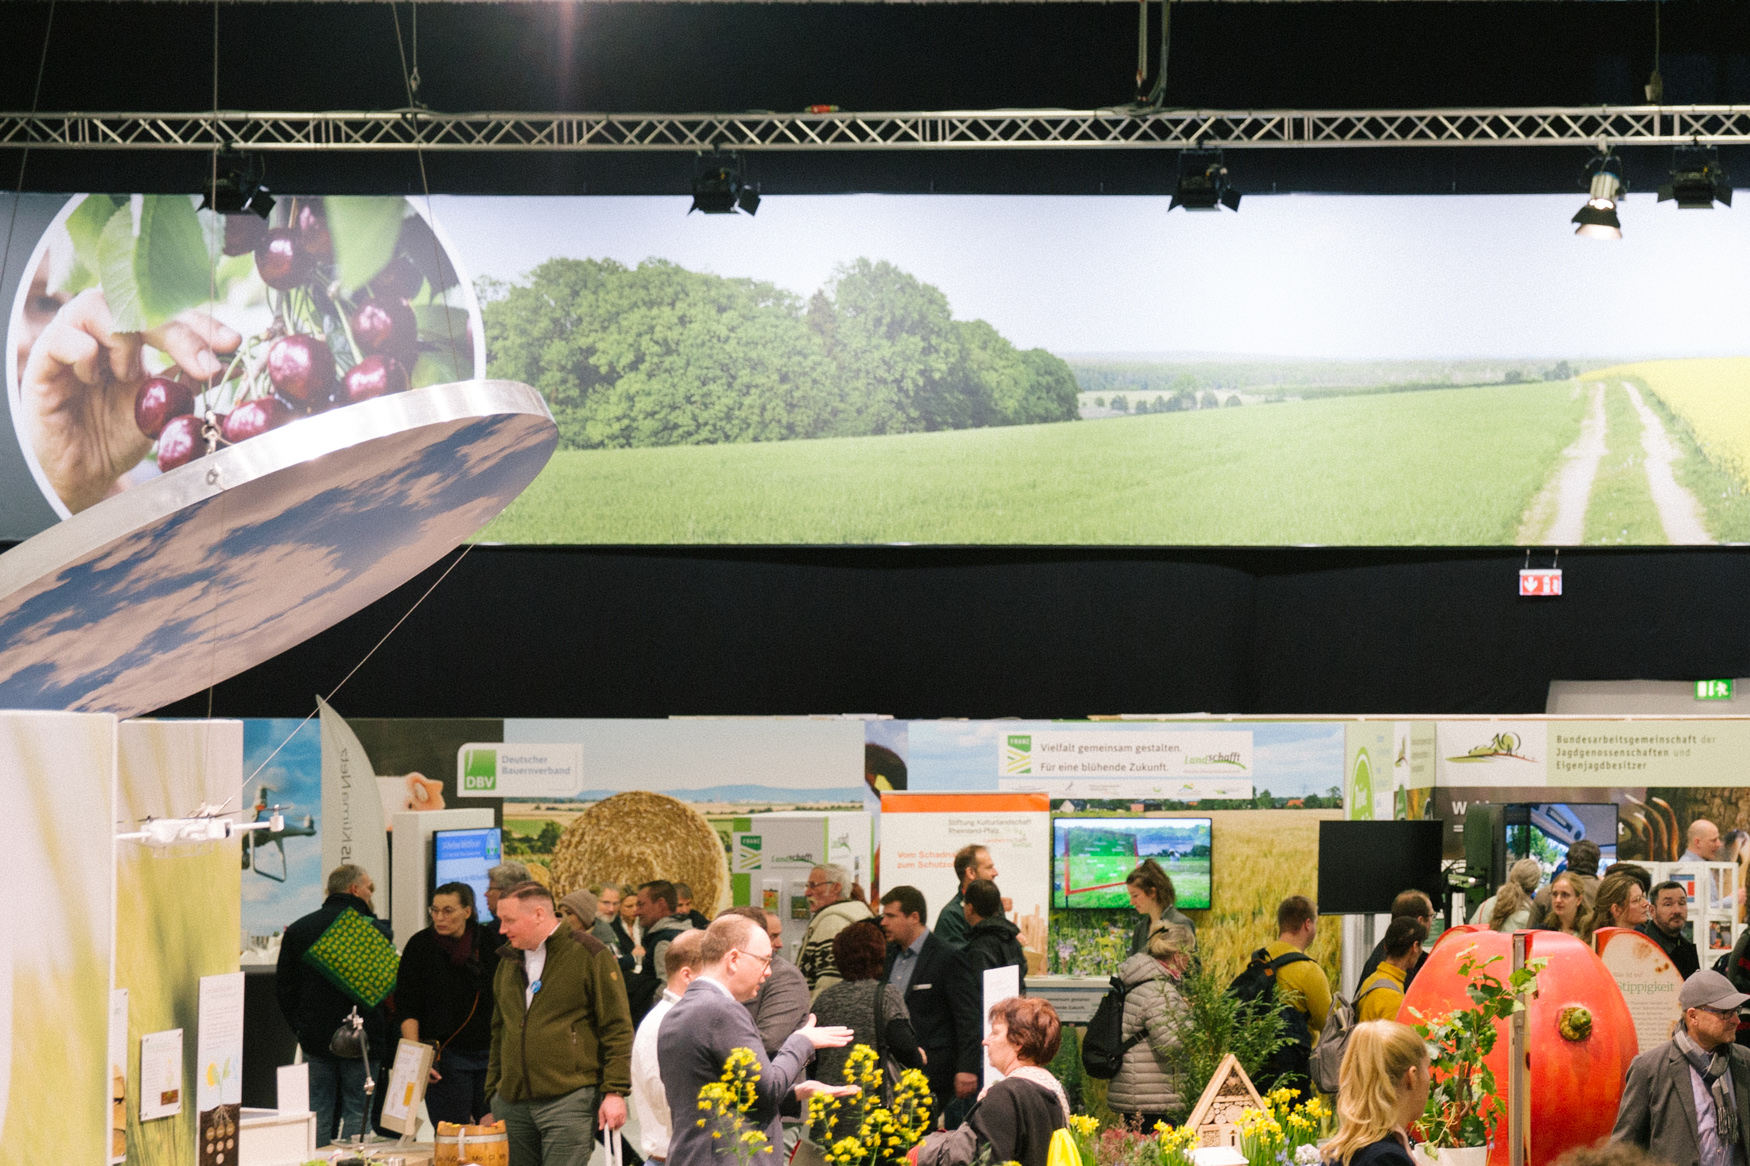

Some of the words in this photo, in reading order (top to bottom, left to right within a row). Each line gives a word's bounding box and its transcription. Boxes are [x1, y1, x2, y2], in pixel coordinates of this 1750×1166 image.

[1556, 735, 1697, 746] Bundesarbeitsgemeinschaft
[1701, 736, 1717, 744] der
[1041, 743, 1075, 752] Vielfalt
[1078, 744, 1133, 754] gemeinsam
[1135, 743, 1182, 754] gestalten.
[1556, 748, 1669, 760] Jagdgenossenschaften
[1674, 748, 1691, 757] und
[502, 755, 547, 764] Deutscher
[502, 767, 571, 775] Bauernverband
[1041, 762, 1056, 772] Für
[1059, 764, 1078, 772] eine
[1081, 762, 1127, 772] blühende
[1129, 762, 1169, 772] Zukunft.
[1556, 760, 1647, 772] Eigenjagdbesitzer
[466, 776, 494, 788] DBV
